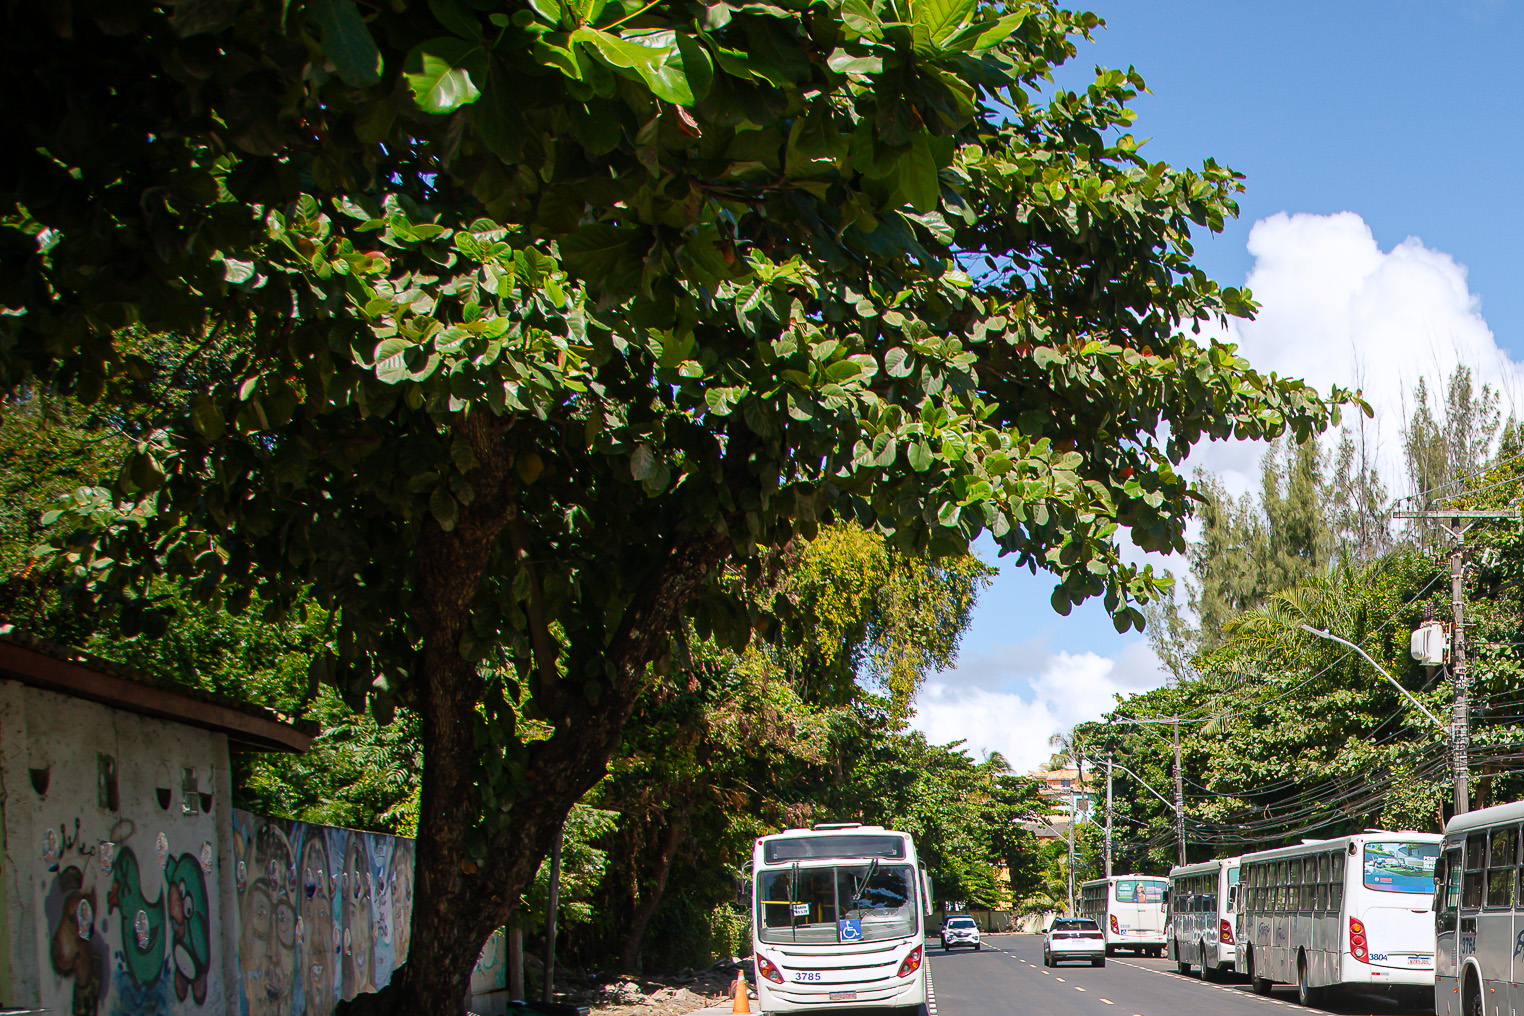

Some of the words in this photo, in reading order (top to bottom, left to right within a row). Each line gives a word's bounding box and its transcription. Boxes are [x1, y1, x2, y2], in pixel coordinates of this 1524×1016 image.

[1462, 937, 1476, 955] 3764
[1369, 953, 1388, 961] 3804
[795, 972, 821, 981] 3785
